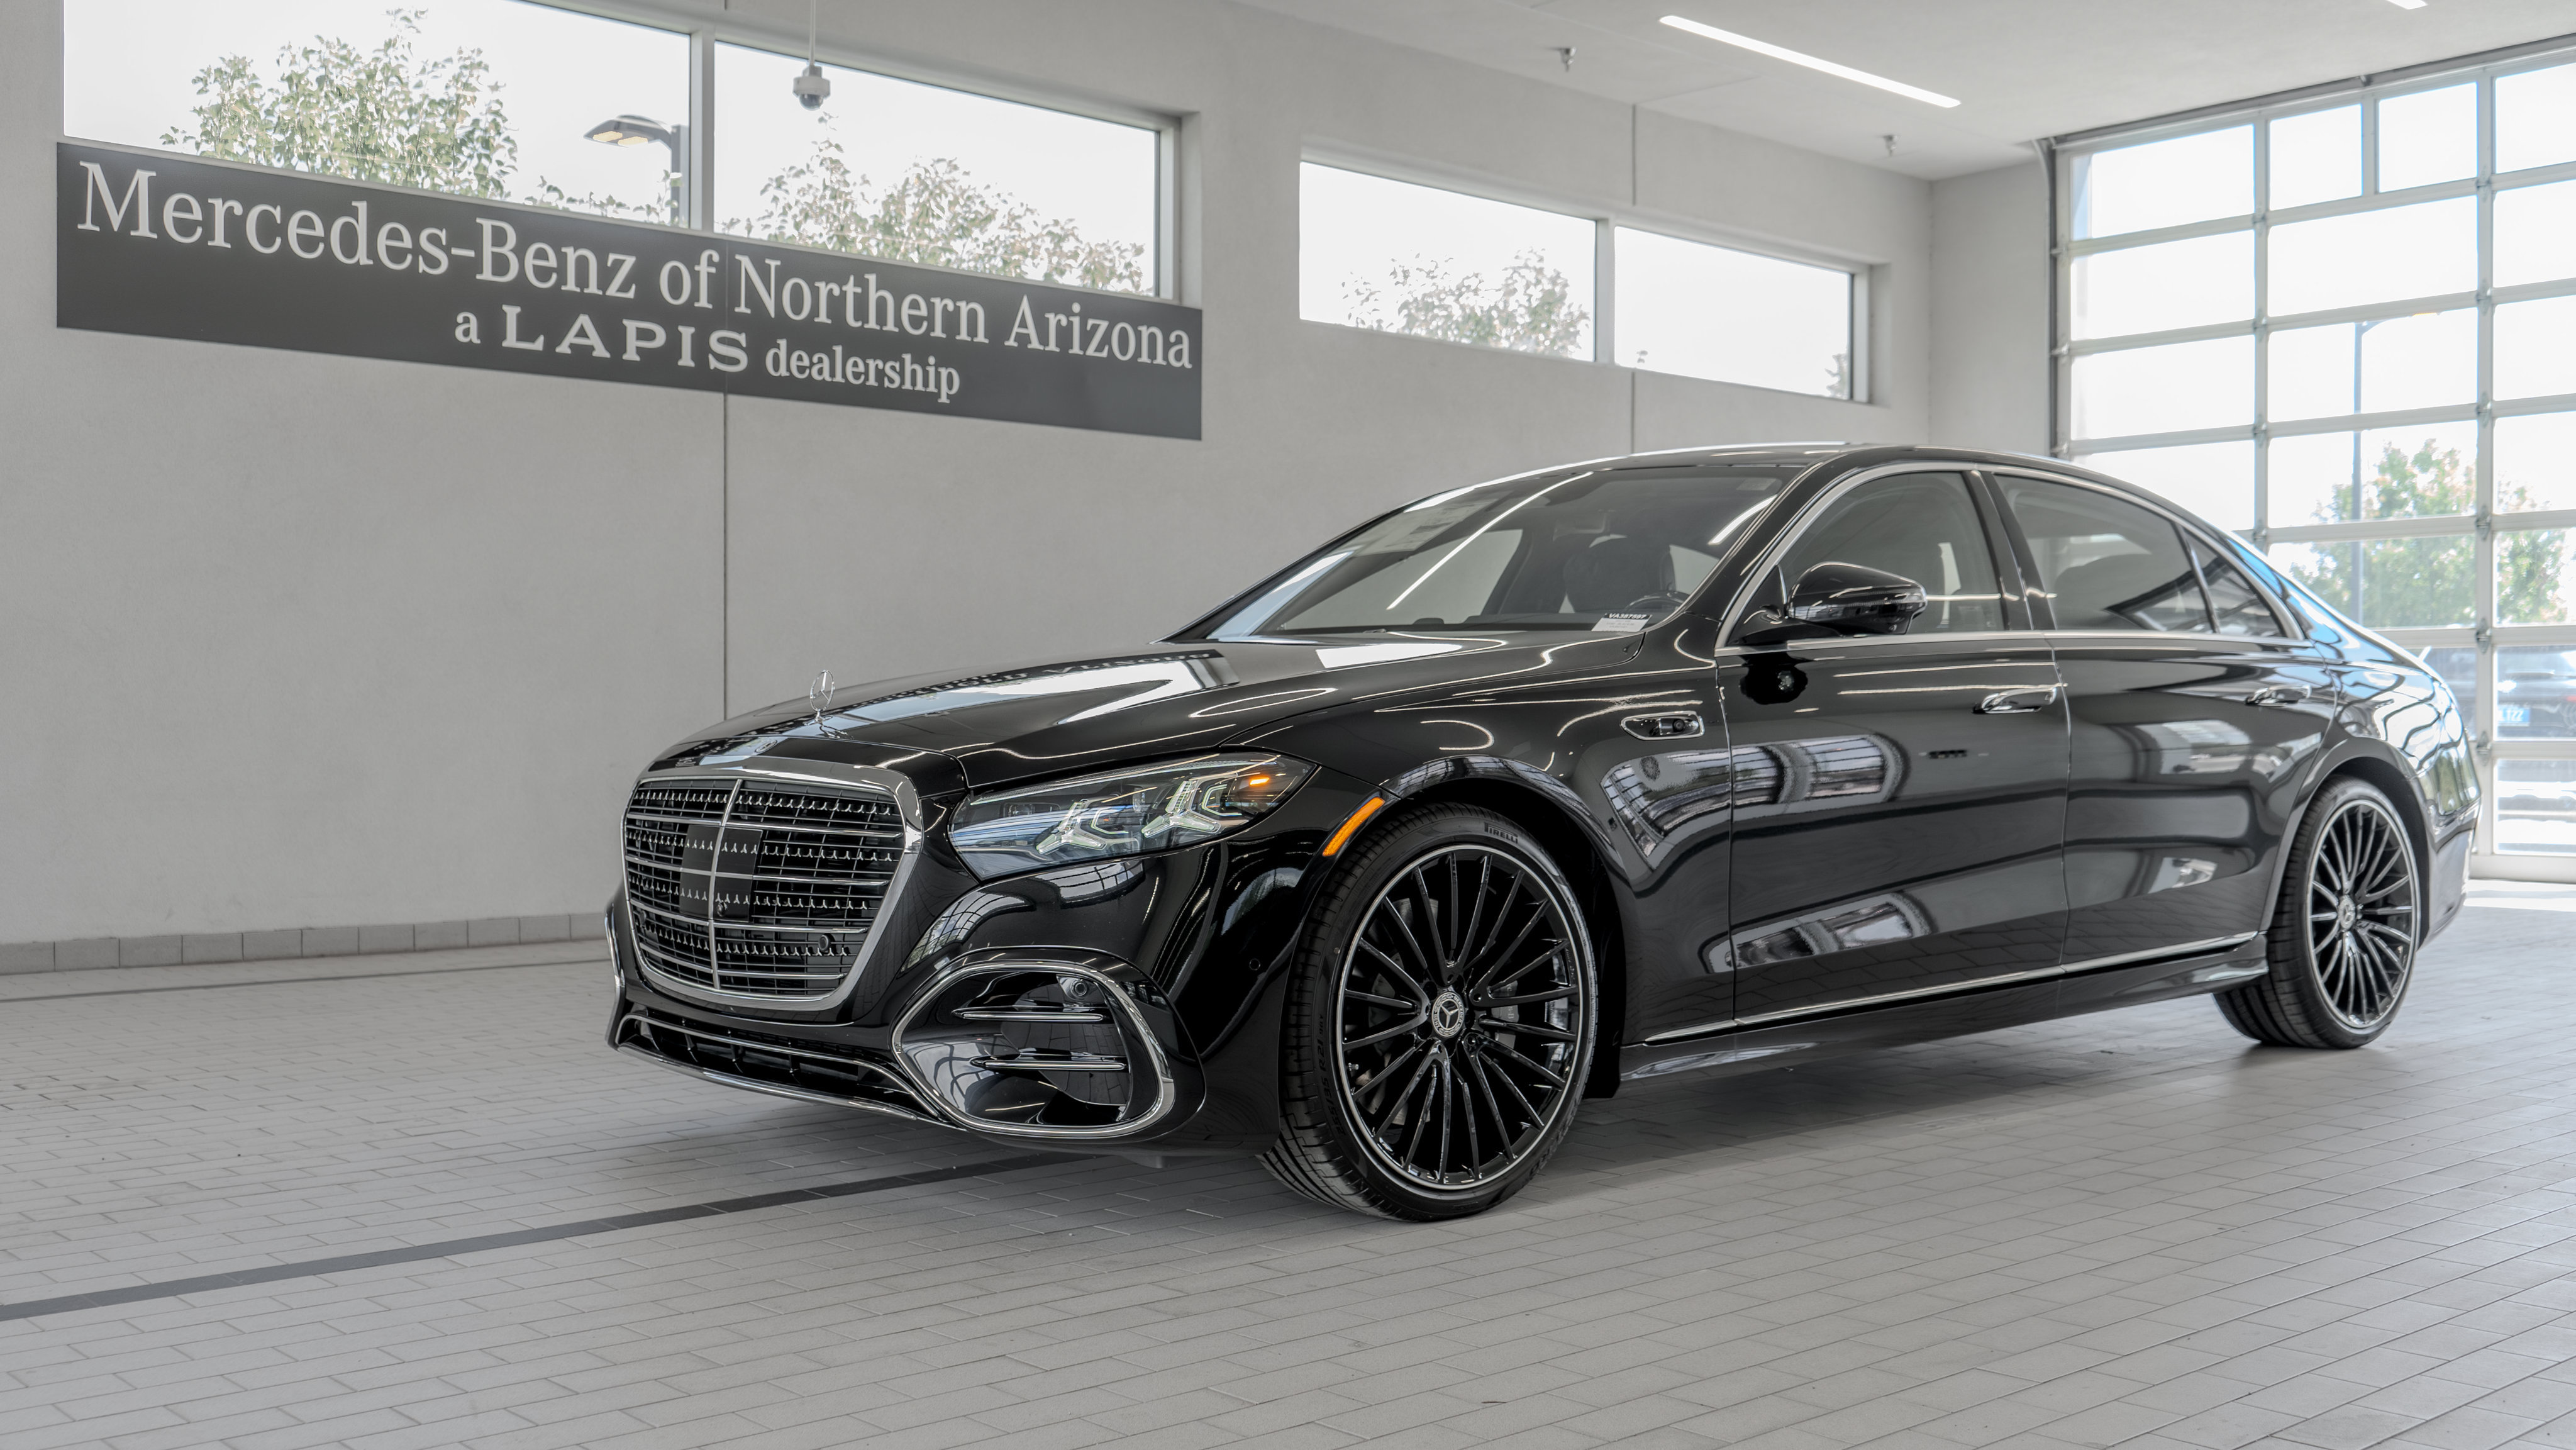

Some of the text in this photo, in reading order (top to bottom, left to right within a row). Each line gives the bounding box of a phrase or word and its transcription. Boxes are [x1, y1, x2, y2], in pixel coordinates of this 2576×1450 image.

[76, 160, 1194, 369] Mercedes-Benz of Northern Arizona
[453, 304, 961, 404] a LAPIS dealership
[1484, 822, 1518, 844] PIRELLI
